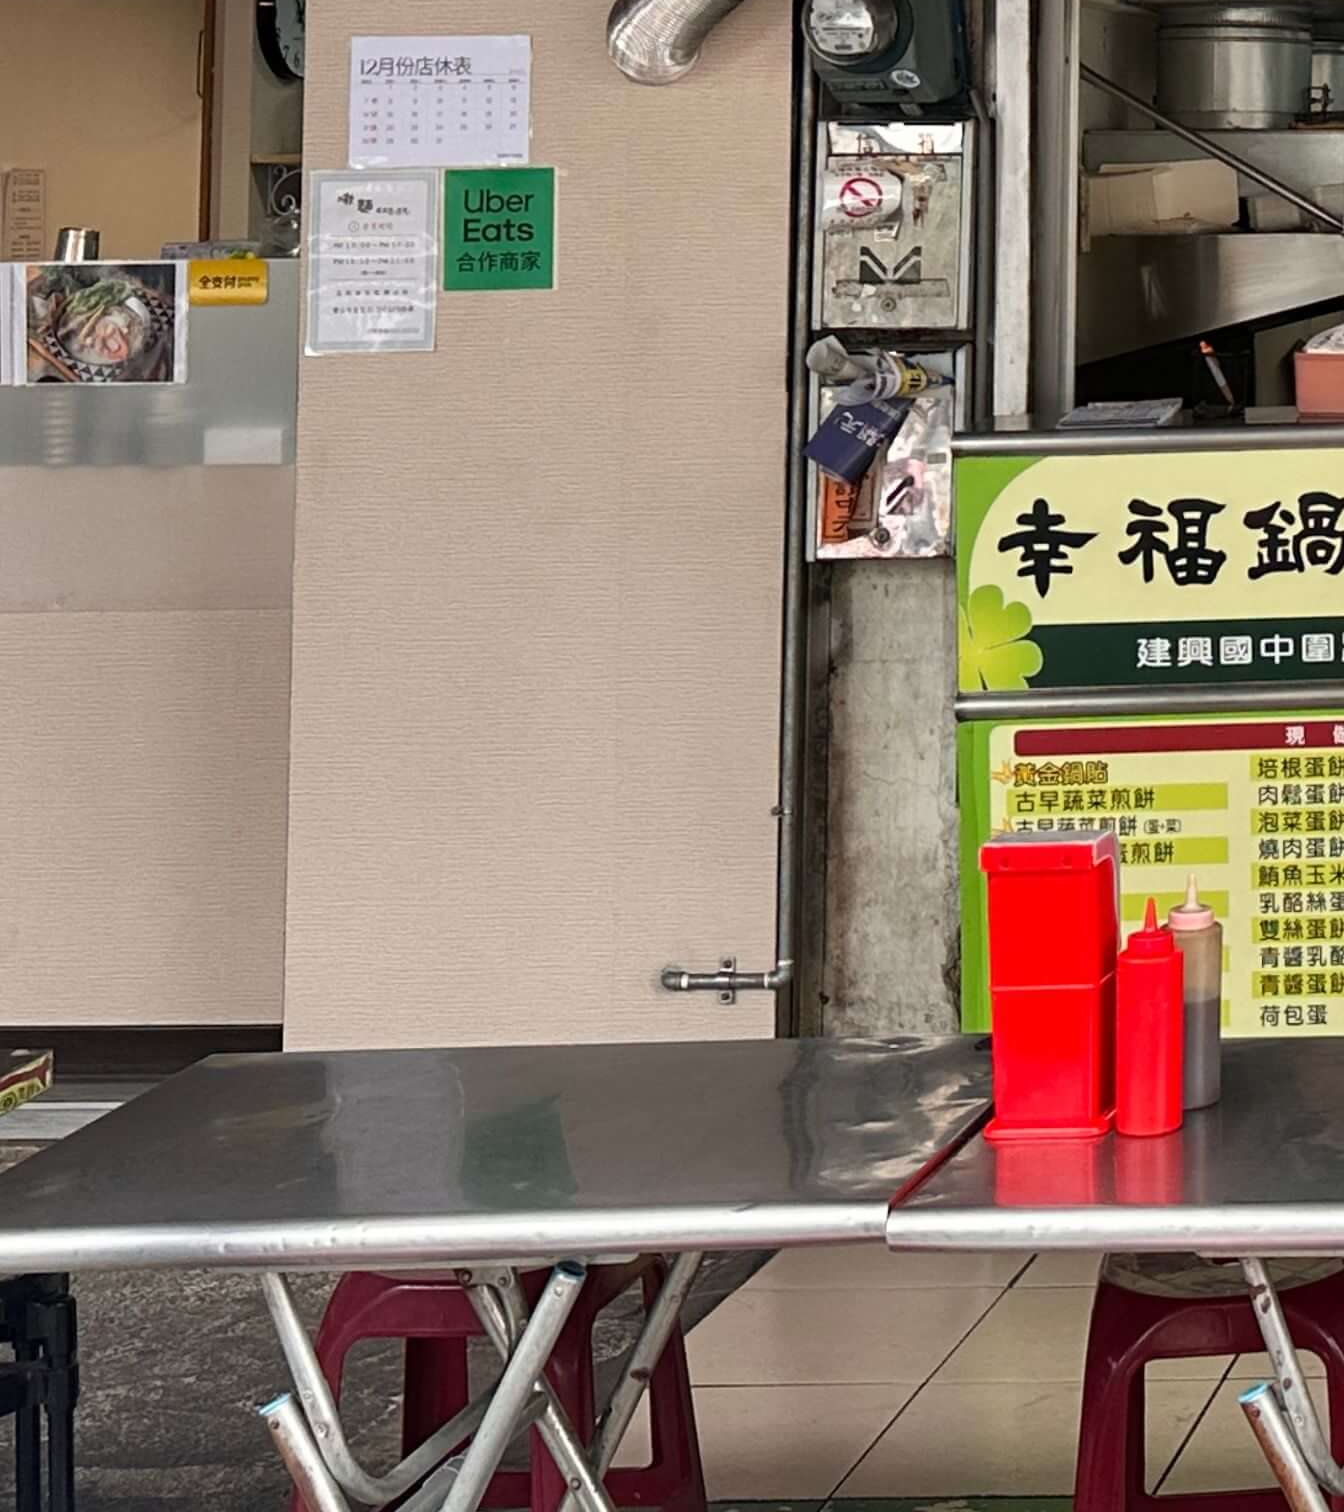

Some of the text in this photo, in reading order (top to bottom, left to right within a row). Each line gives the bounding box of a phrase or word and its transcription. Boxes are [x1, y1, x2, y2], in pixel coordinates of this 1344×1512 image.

[464, 189, 535, 214] Uber
[463, 219, 534, 242] Eats
[456, 251, 542, 273] 合作商家
[1014, 761, 1109, 787] 黃金鍋貼
[1015, 786, 1155, 813] 古早蔬菜煎餅
[1260, 1004, 1328, 1027] 荷包蛋
